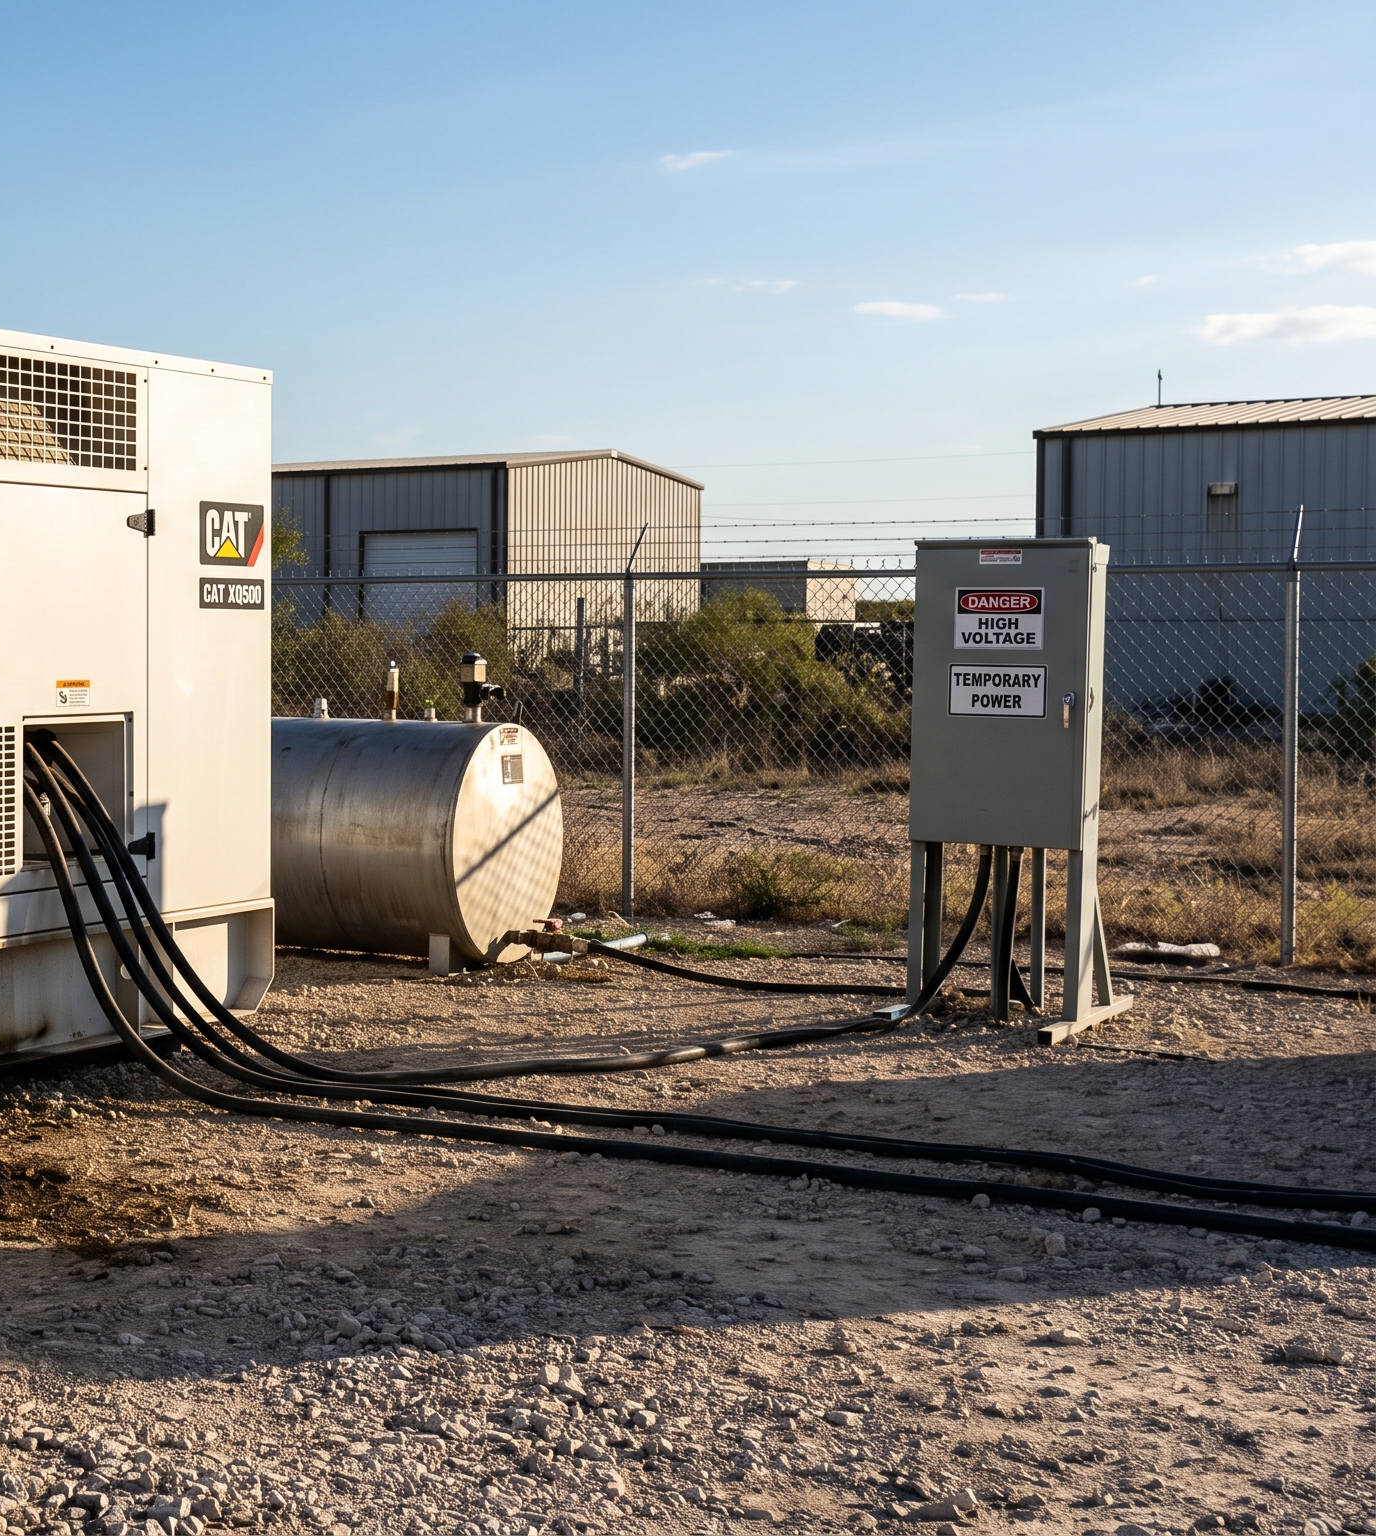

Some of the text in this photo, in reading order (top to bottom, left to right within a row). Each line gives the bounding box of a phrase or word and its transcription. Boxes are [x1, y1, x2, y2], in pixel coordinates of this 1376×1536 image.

[206, 509, 249, 558] CAT
[203, 583, 261, 605] CAT XQ500
[968, 597, 1030, 608] DANGER
[978, 618, 1019, 630] HIGH
[961, 632, 1035, 645] VOLTAGE
[954, 673, 1041, 688] TEMPORARY
[971, 694, 1021, 709] POWER
